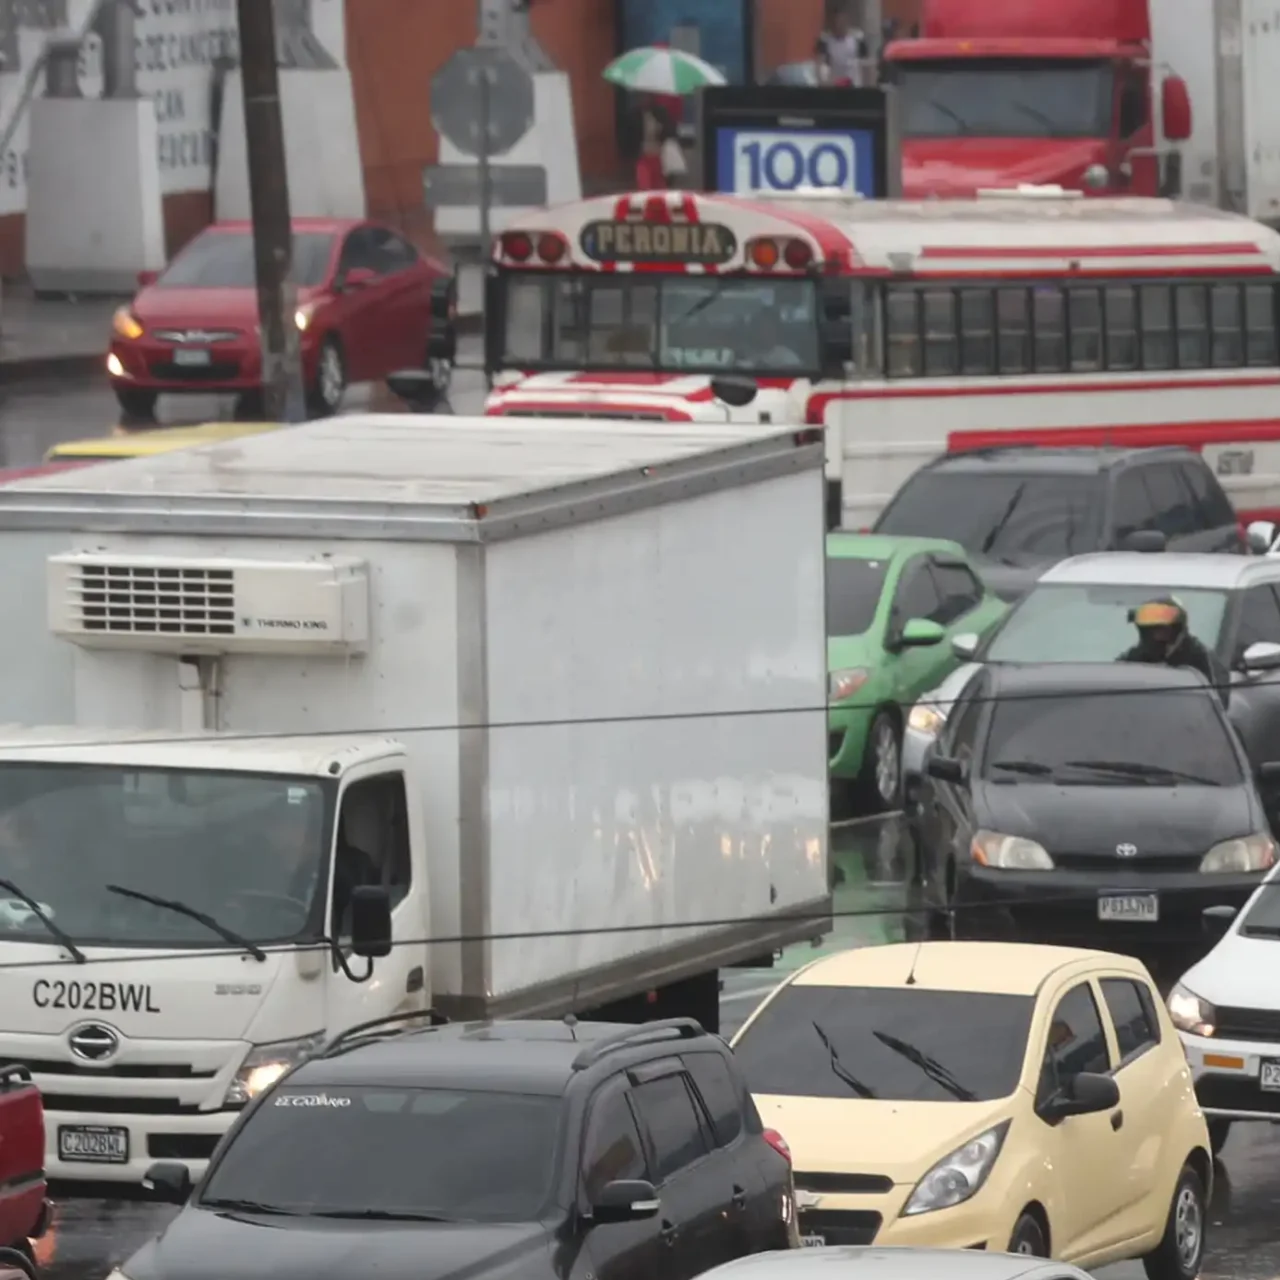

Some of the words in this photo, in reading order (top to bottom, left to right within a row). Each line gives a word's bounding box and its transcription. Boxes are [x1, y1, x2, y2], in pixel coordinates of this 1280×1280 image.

[741, 142, 848, 191] 100
[598, 223, 722, 254] PERONIA
[33, 978, 161, 1014] C202BWL
[63, 1133, 126, 1155] C202BWL
